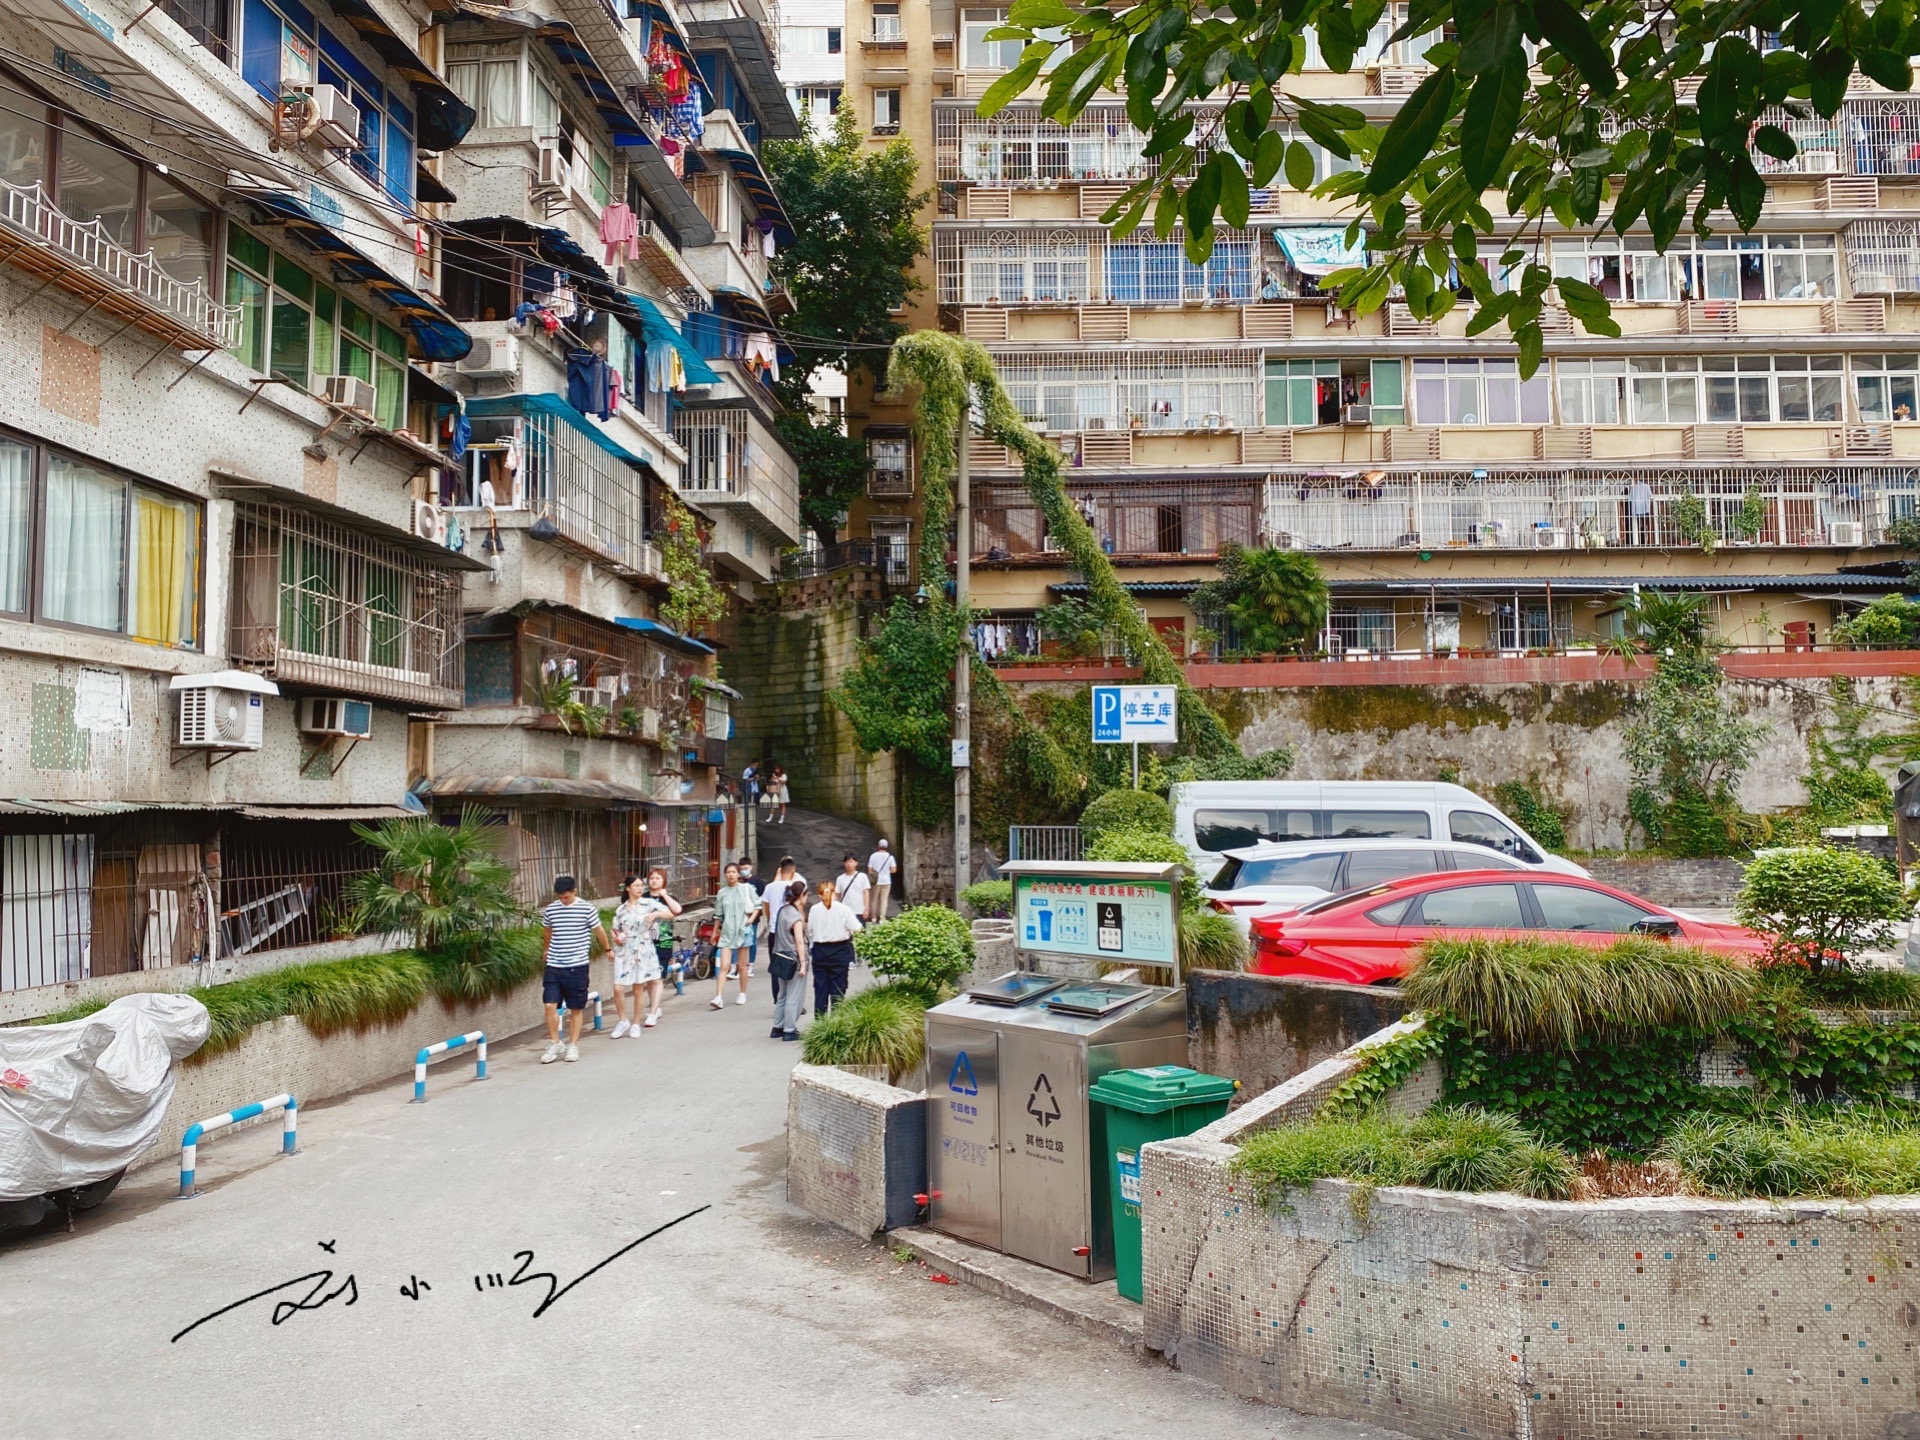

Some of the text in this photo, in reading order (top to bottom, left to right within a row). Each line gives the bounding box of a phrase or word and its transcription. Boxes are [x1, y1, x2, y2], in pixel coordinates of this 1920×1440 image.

[1099, 692, 1117, 726] P
[1123, 701, 1173, 718] 停车库
[1097, 728, 1121, 738] 24小时
[1088, 884, 1155, 898] 建设美丽朝天门
[949, 1101, 978, 1117] 可回收物
[1025, 1133, 1064, 1153] 其他垃圾
